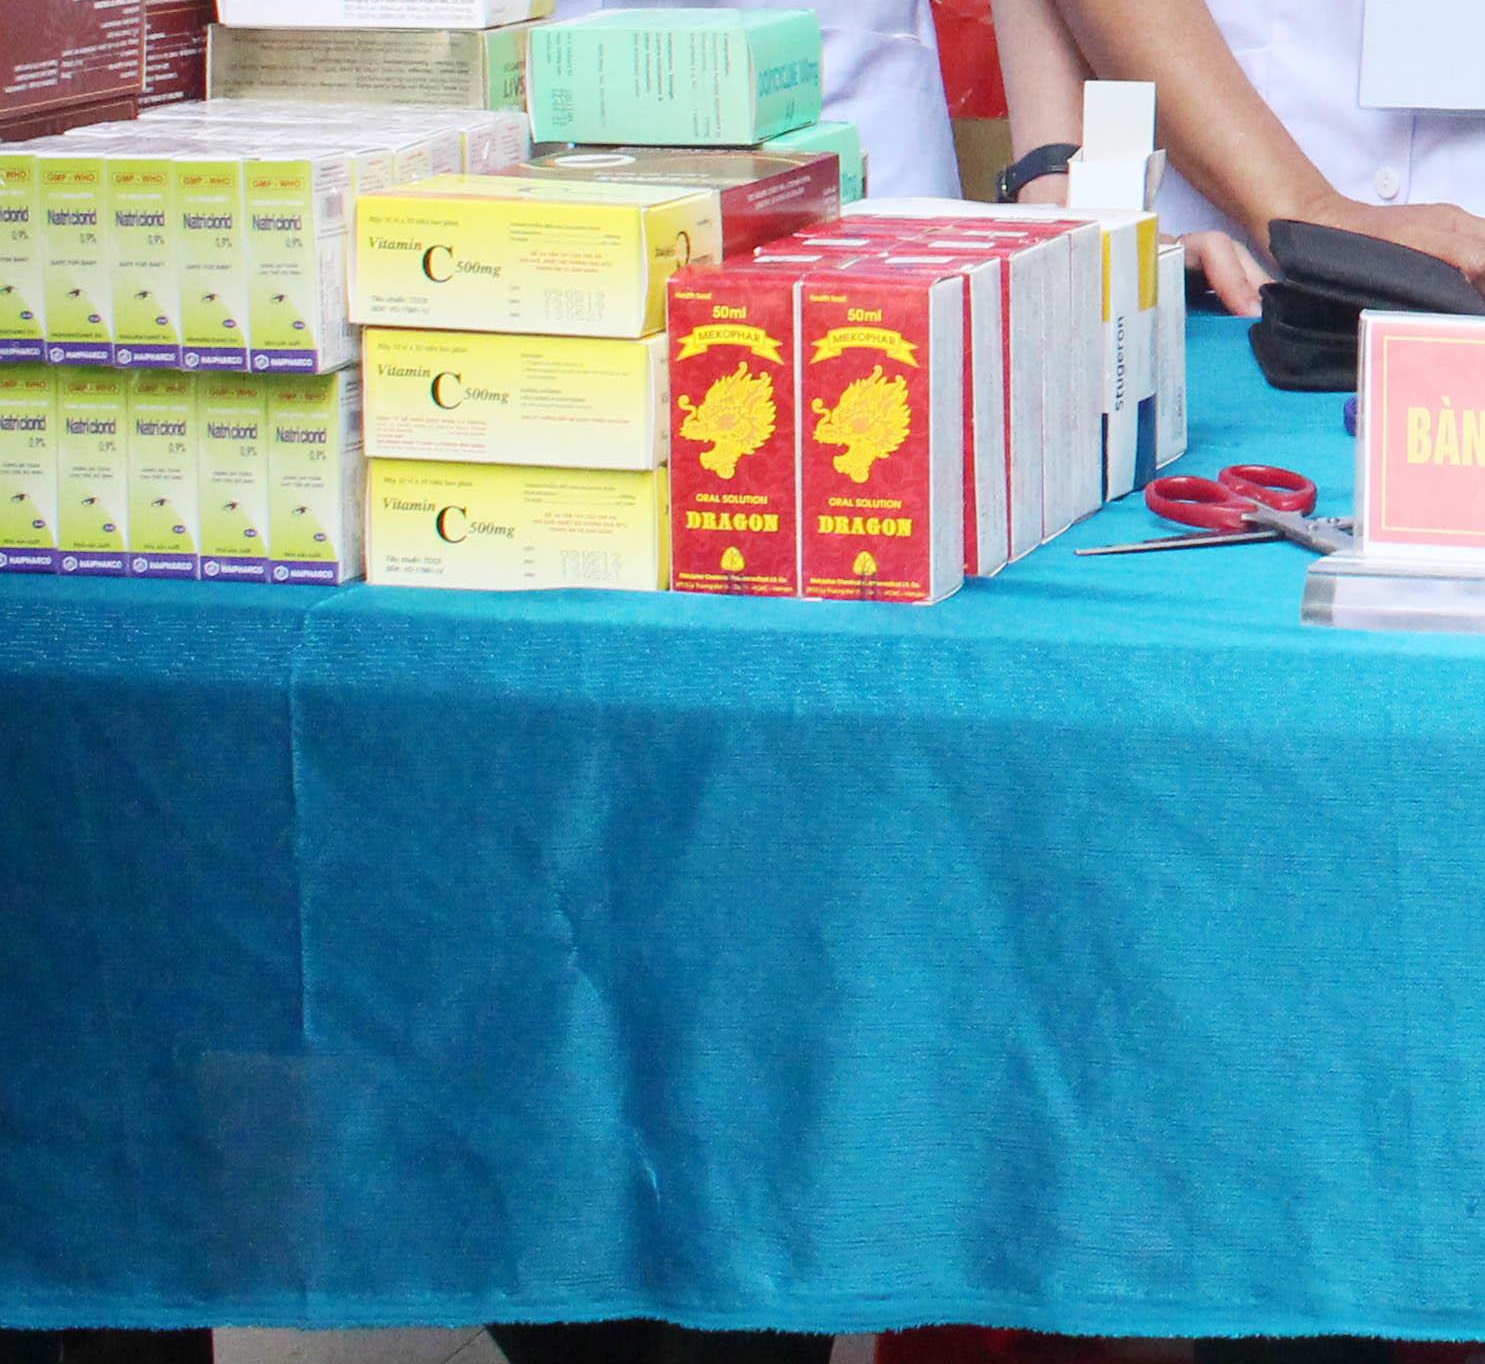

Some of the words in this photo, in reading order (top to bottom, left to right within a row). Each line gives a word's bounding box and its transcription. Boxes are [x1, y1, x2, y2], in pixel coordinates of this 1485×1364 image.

[368, 236, 423, 251] Vitamin
[422, 245, 453, 283] C
[455, 259, 501, 277] 500mg
[712, 306, 747, 319] 50ml
[847, 308, 882, 323] 50ml
[698, 329, 760, 342] MEKOPHAR
[833, 333, 895, 345] MEKOPHAR
[1115, 315, 1125, 412] Stugeron
[377, 363, 431, 378] Vitamin
[430, 371, 462, 410] C
[464, 387, 509, 404] 500mg
[696, 493, 721, 503] ORAL
[722, 494, 768, 505] SOLUTION
[828, 496, 853, 507] ORAL
[855, 498, 901, 509] SOLUTION
[383, 497, 435, 512] Vitamin
[436, 505, 467, 543] C
[468, 521, 515, 538] 500mg
[686, 511, 779, 533] DRAGON
[818, 515, 912, 537] DRAGON
